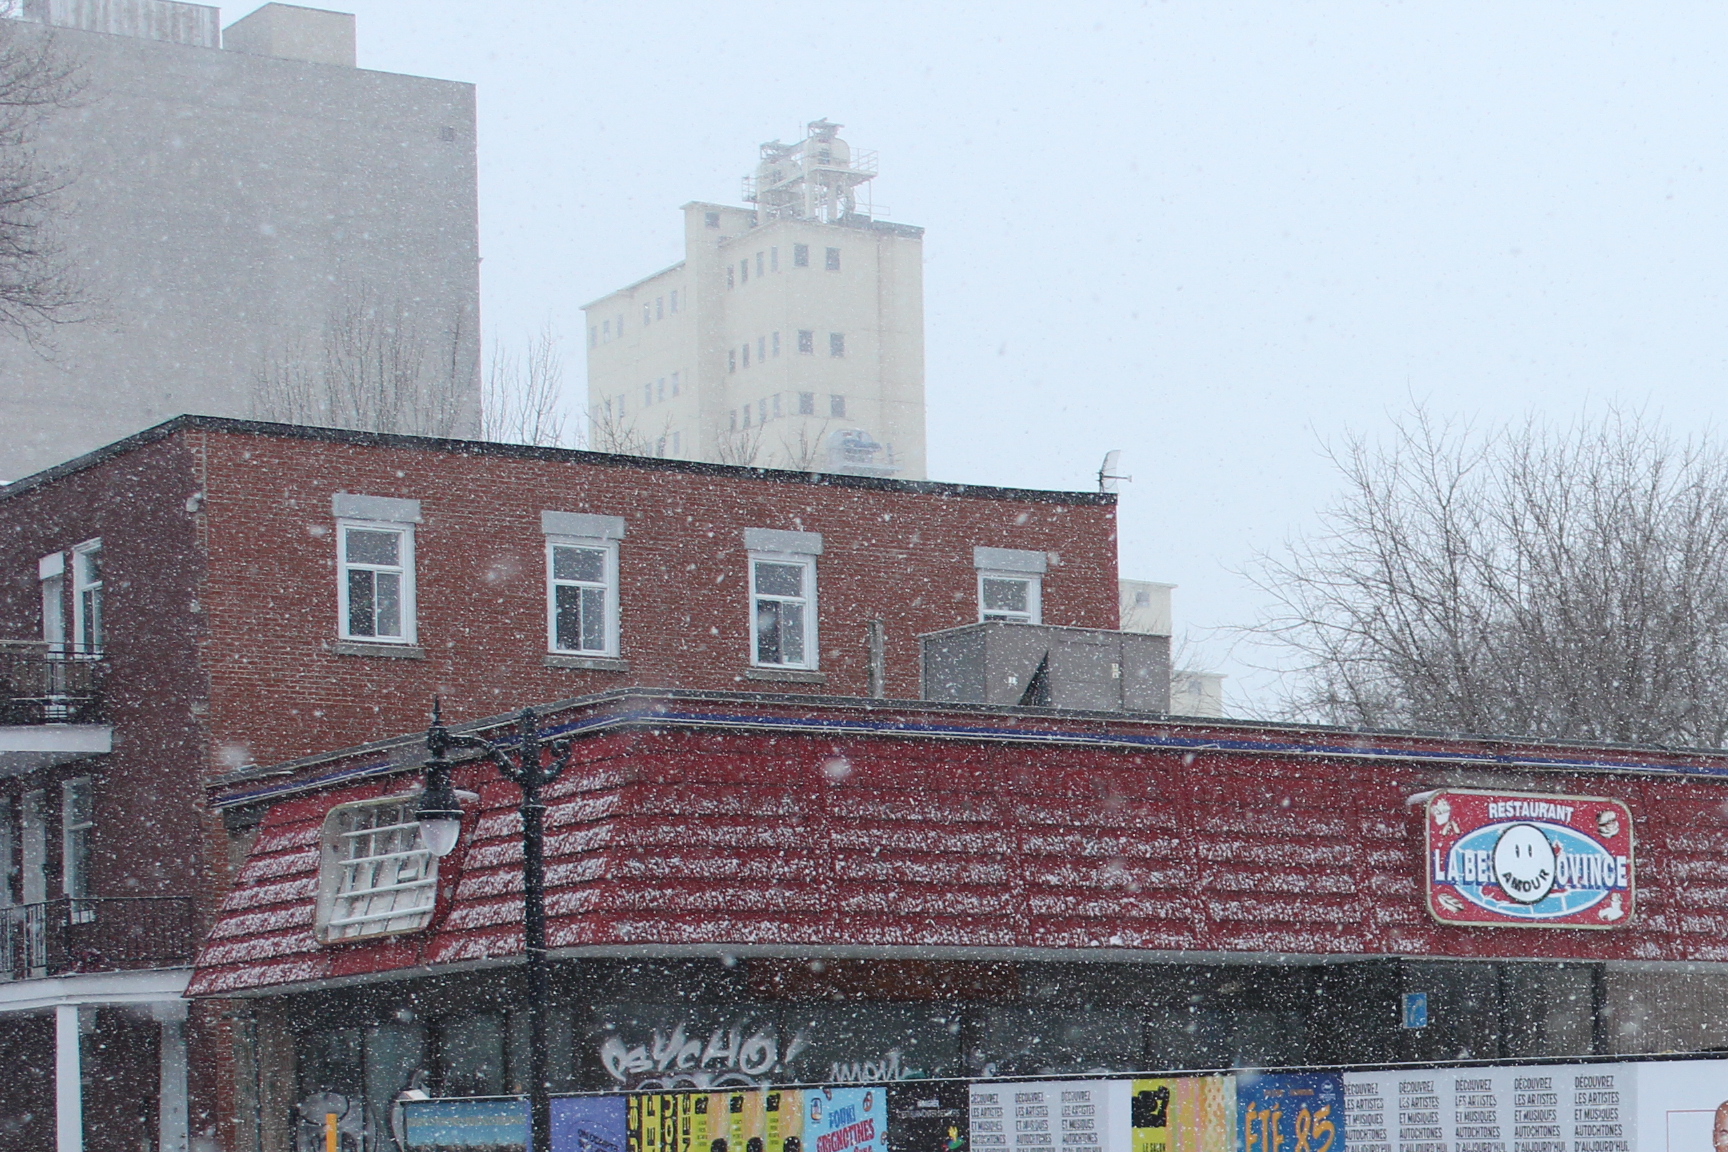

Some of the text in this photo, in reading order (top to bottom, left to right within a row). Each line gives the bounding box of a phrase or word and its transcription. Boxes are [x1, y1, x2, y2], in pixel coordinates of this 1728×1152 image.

[1488, 802, 1574, 822] RESTAURANT
[1501, 869, 1550, 892] AMOUR
[1455, 1077, 1492, 1091] DÉCOUVREZ
[1514, 1076, 1552, 1090] DÉCOUVREZ
[1574, 1074, 1614, 1088] DÉCOUVREZ
[1455, 1095, 1497, 1107] LES ARTISTES
[1514, 1093, 1558, 1105] LES ARTISTES
[1574, 1092, 1619, 1104] LES ARTISTES
[1455, 1111, 1463, 1122] ET
[1514, 1110, 1522, 1121] ET
[1575, 1109, 1582, 1120] ET
[1455, 1127, 1500, 1138] AUTOCHTONES
[1514, 1125, 1561, 1137] AUTOCHTONES
[1575, 1125, 1622, 1136] AUTOCHTONES
